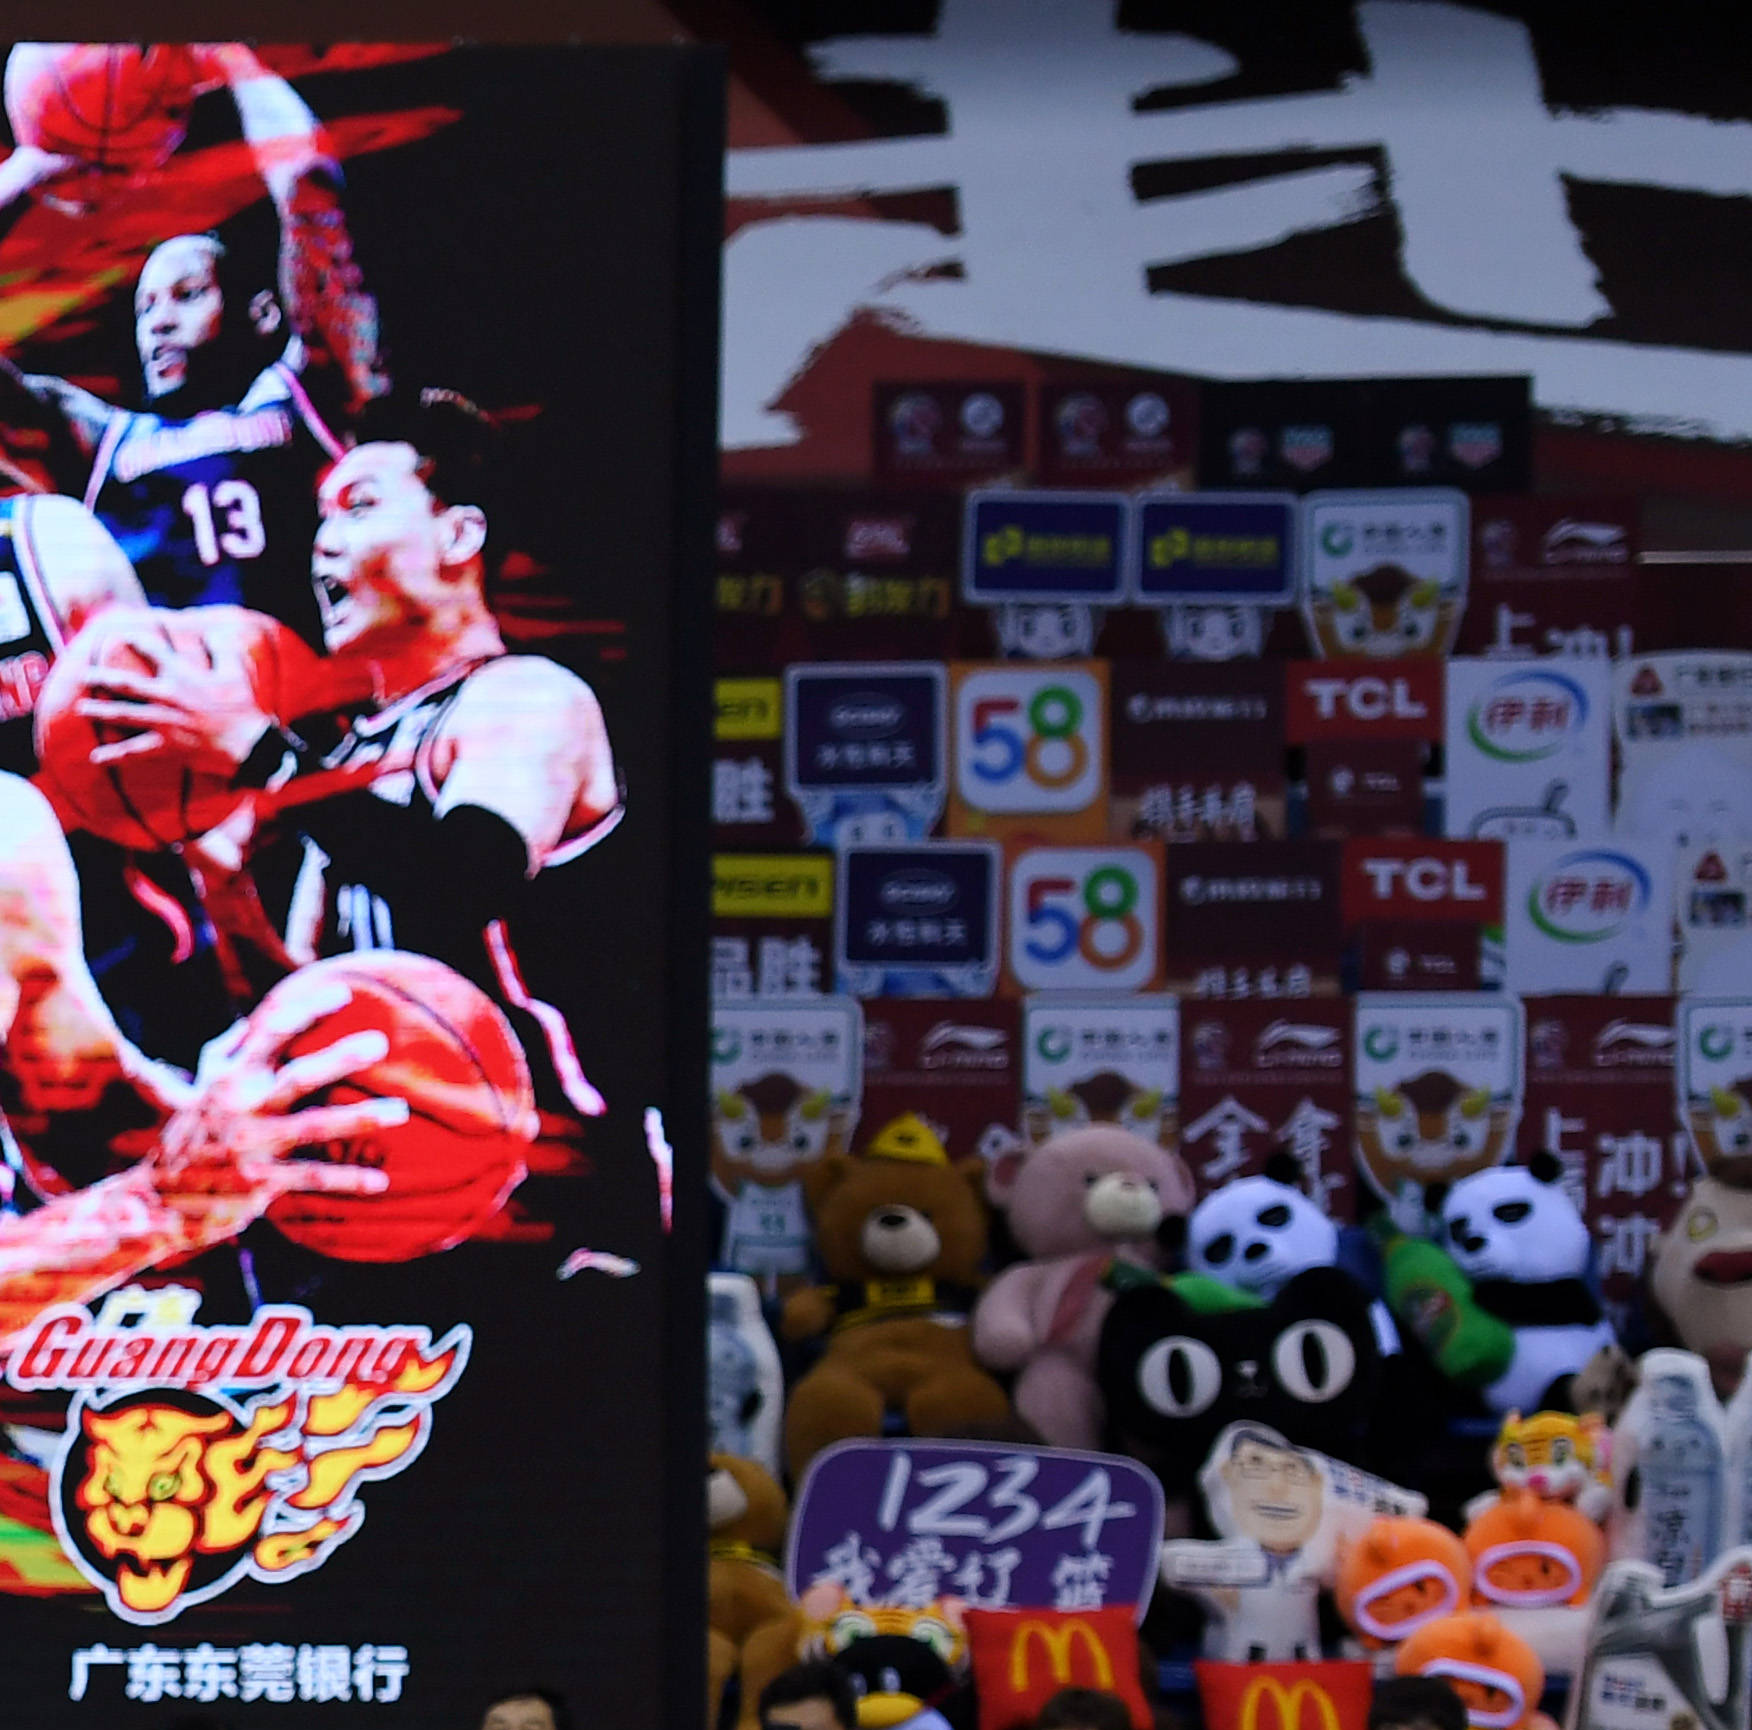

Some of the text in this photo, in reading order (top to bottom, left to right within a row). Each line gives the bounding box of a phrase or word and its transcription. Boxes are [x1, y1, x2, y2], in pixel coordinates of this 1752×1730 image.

[182, 479, 266, 567] 13
[1303, 676, 1427, 721] TCL
[1486, 700, 1571, 731] 伊利
[971, 684, 1087, 790] 58
[1360, 857, 1487, 902] TCL
[1546, 881, 1632, 912] 伊利
[1025, 865, 1142, 970] 58
[878, 1448, 1138, 1552] 1234
[68, 1641, 412, 1703] 广东东莞银行
